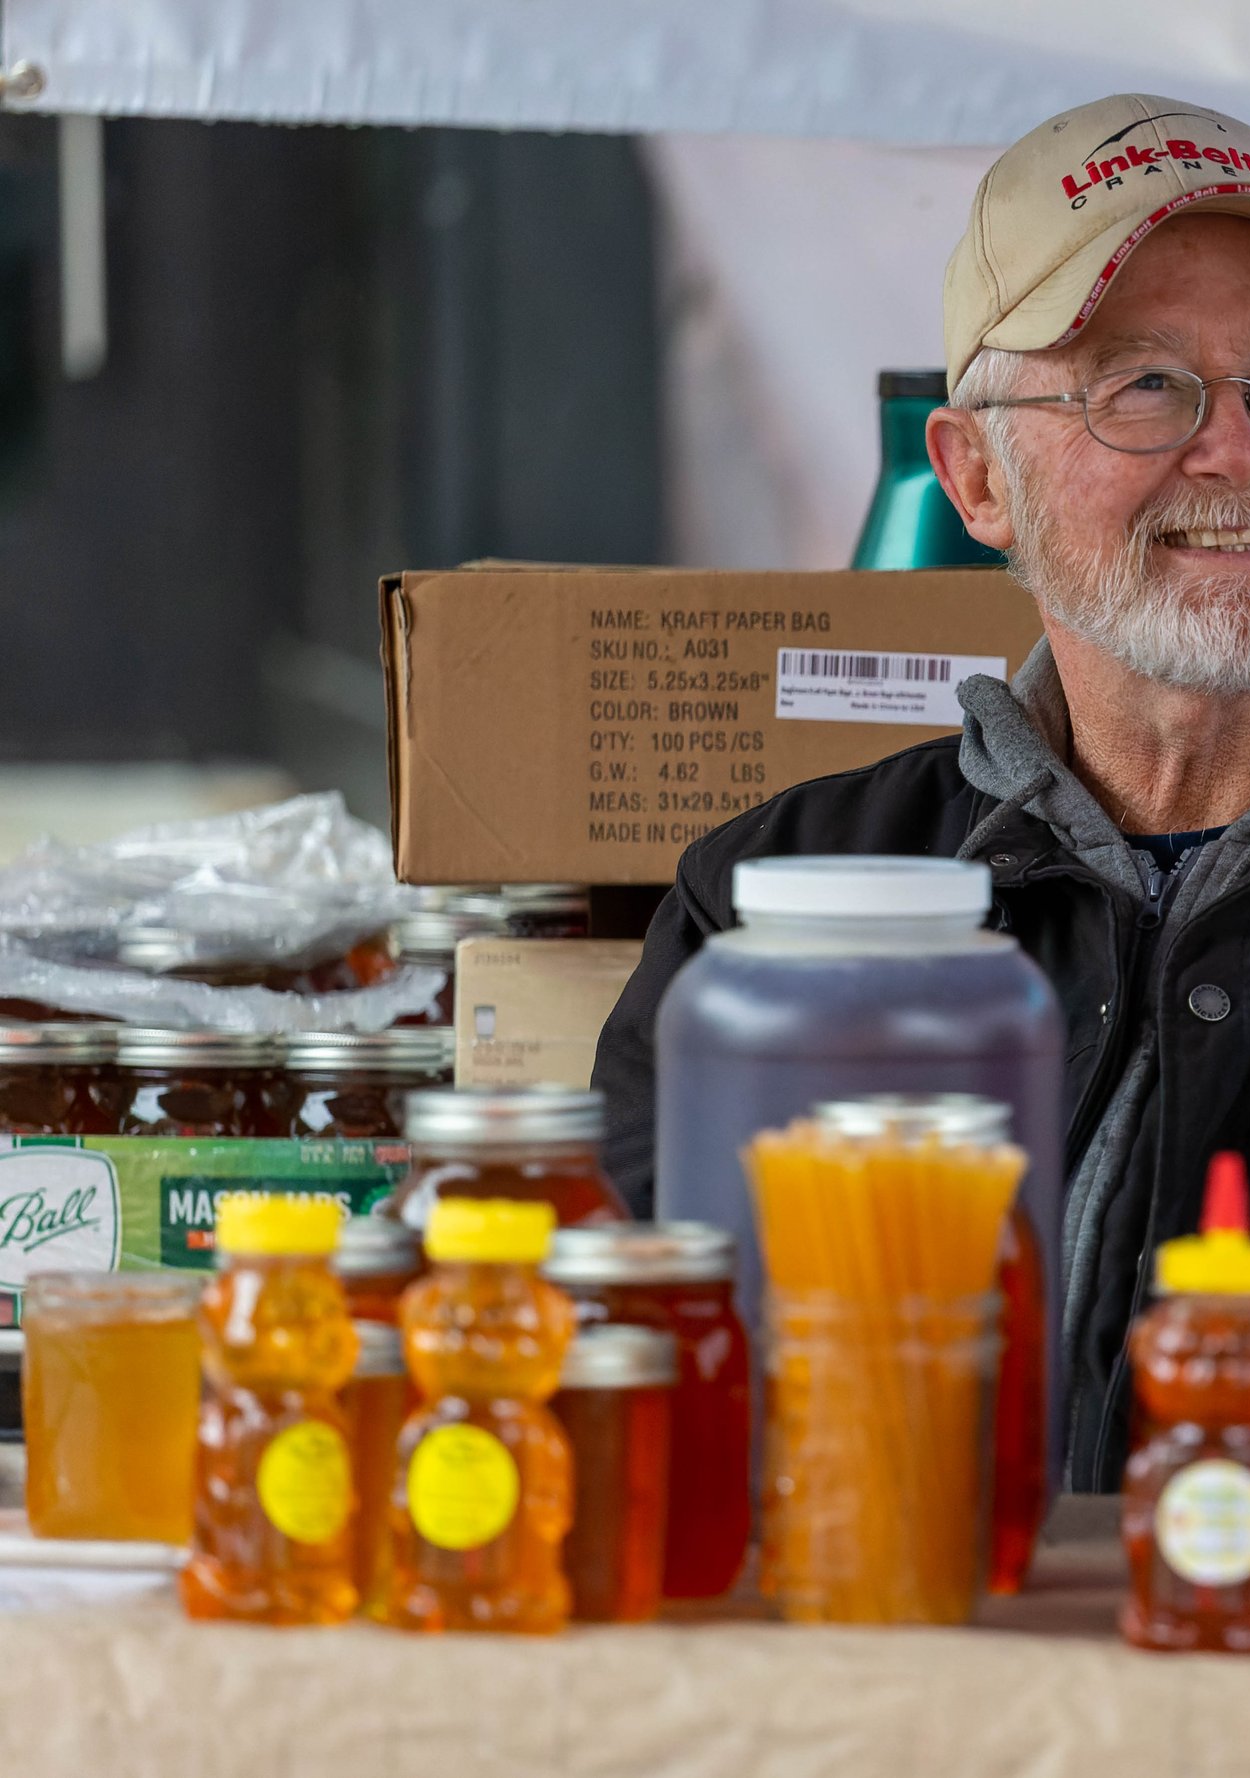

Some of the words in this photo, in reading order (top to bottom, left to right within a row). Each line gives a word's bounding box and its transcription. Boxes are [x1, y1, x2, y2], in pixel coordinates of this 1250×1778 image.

[1166, 186, 1218, 211] Link-Belt
[590, 609, 649, 629] NAME:
[660, 610, 719, 630] KRAFT
[725, 611, 786, 631] PAPER
[791, 611, 831, 632] BAG
[590, 639, 627, 660] SKU
[683, 639, 728, 660] A031
[590, 670, 635, 691] SIZE:
[590, 701, 658, 721] COLOR:
[668, 701, 738, 721] BROWN
[590, 730, 634, 751] Q'TY:
[652, 732, 684, 752] 100
[658, 762, 699, 782] 4.62
[730, 763, 766, 784] LBS
[590, 792, 647, 812] MEAS:
[589, 822, 641, 843] MADE
[647, 823, 666, 843] IN
[670, 823, 714, 843] CHI
[0, 1185, 101, 1252] Ball
